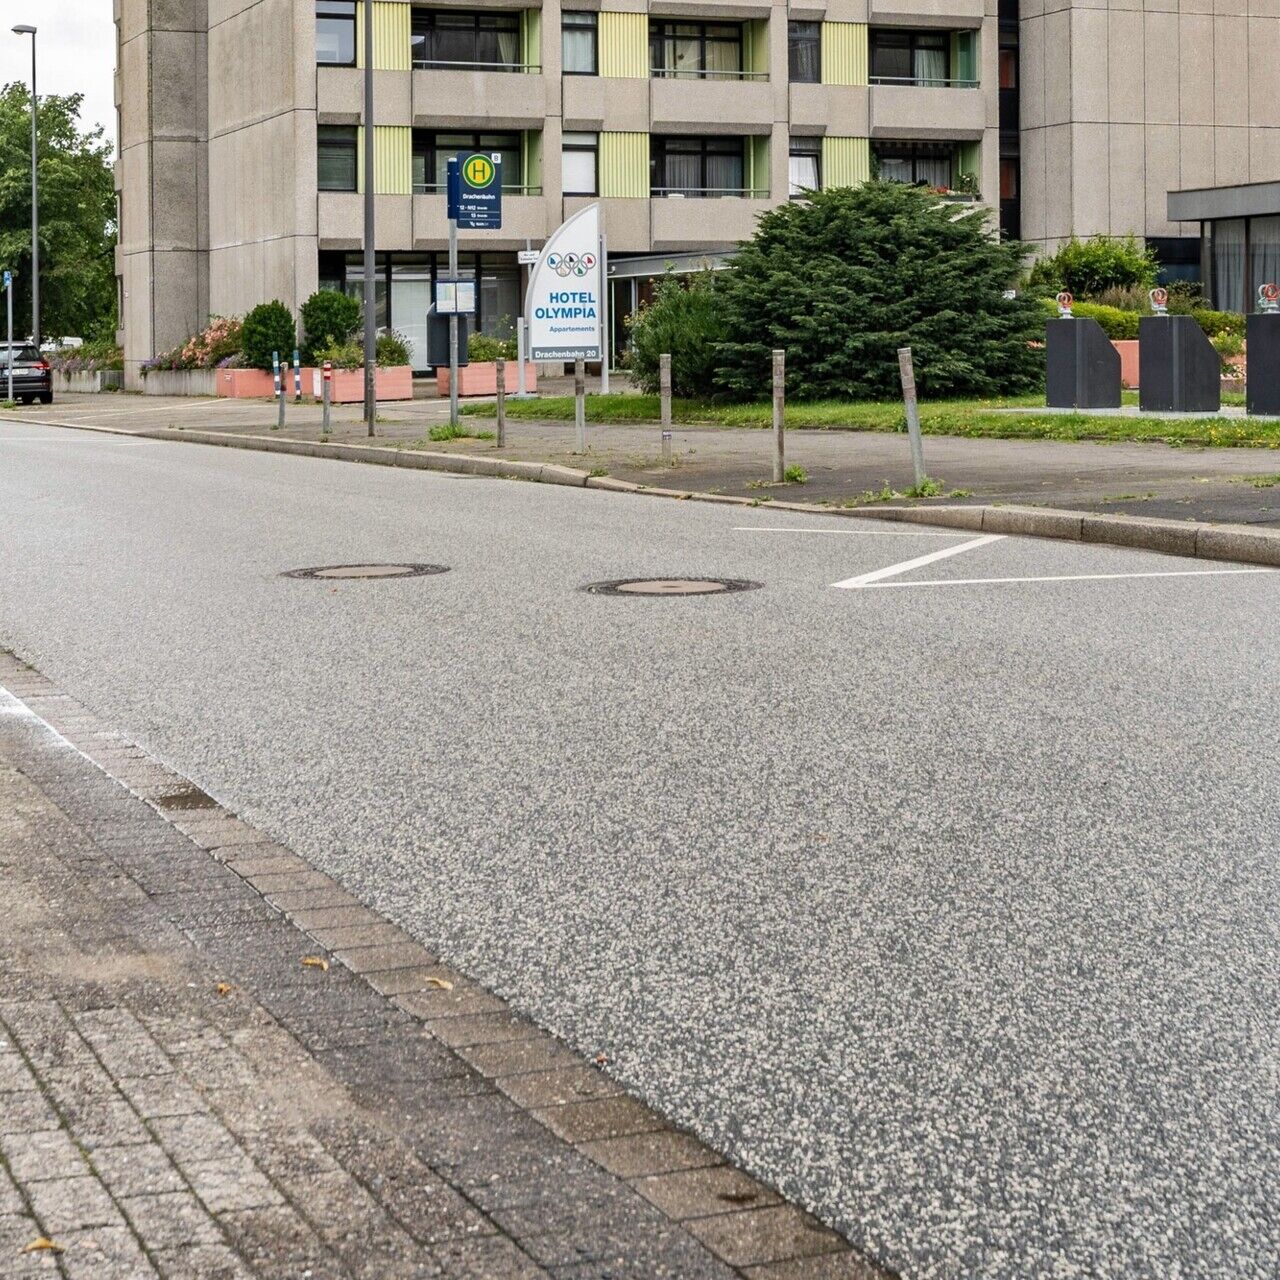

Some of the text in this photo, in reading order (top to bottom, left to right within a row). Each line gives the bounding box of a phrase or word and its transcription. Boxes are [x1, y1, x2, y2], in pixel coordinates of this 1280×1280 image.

[473, 162, 485, 180] H
[549, 292, 596, 304] HOTEL
[535, 307, 596, 319] OLYMPIA
[535, 350, 596, 359] Drachenbahn 20
